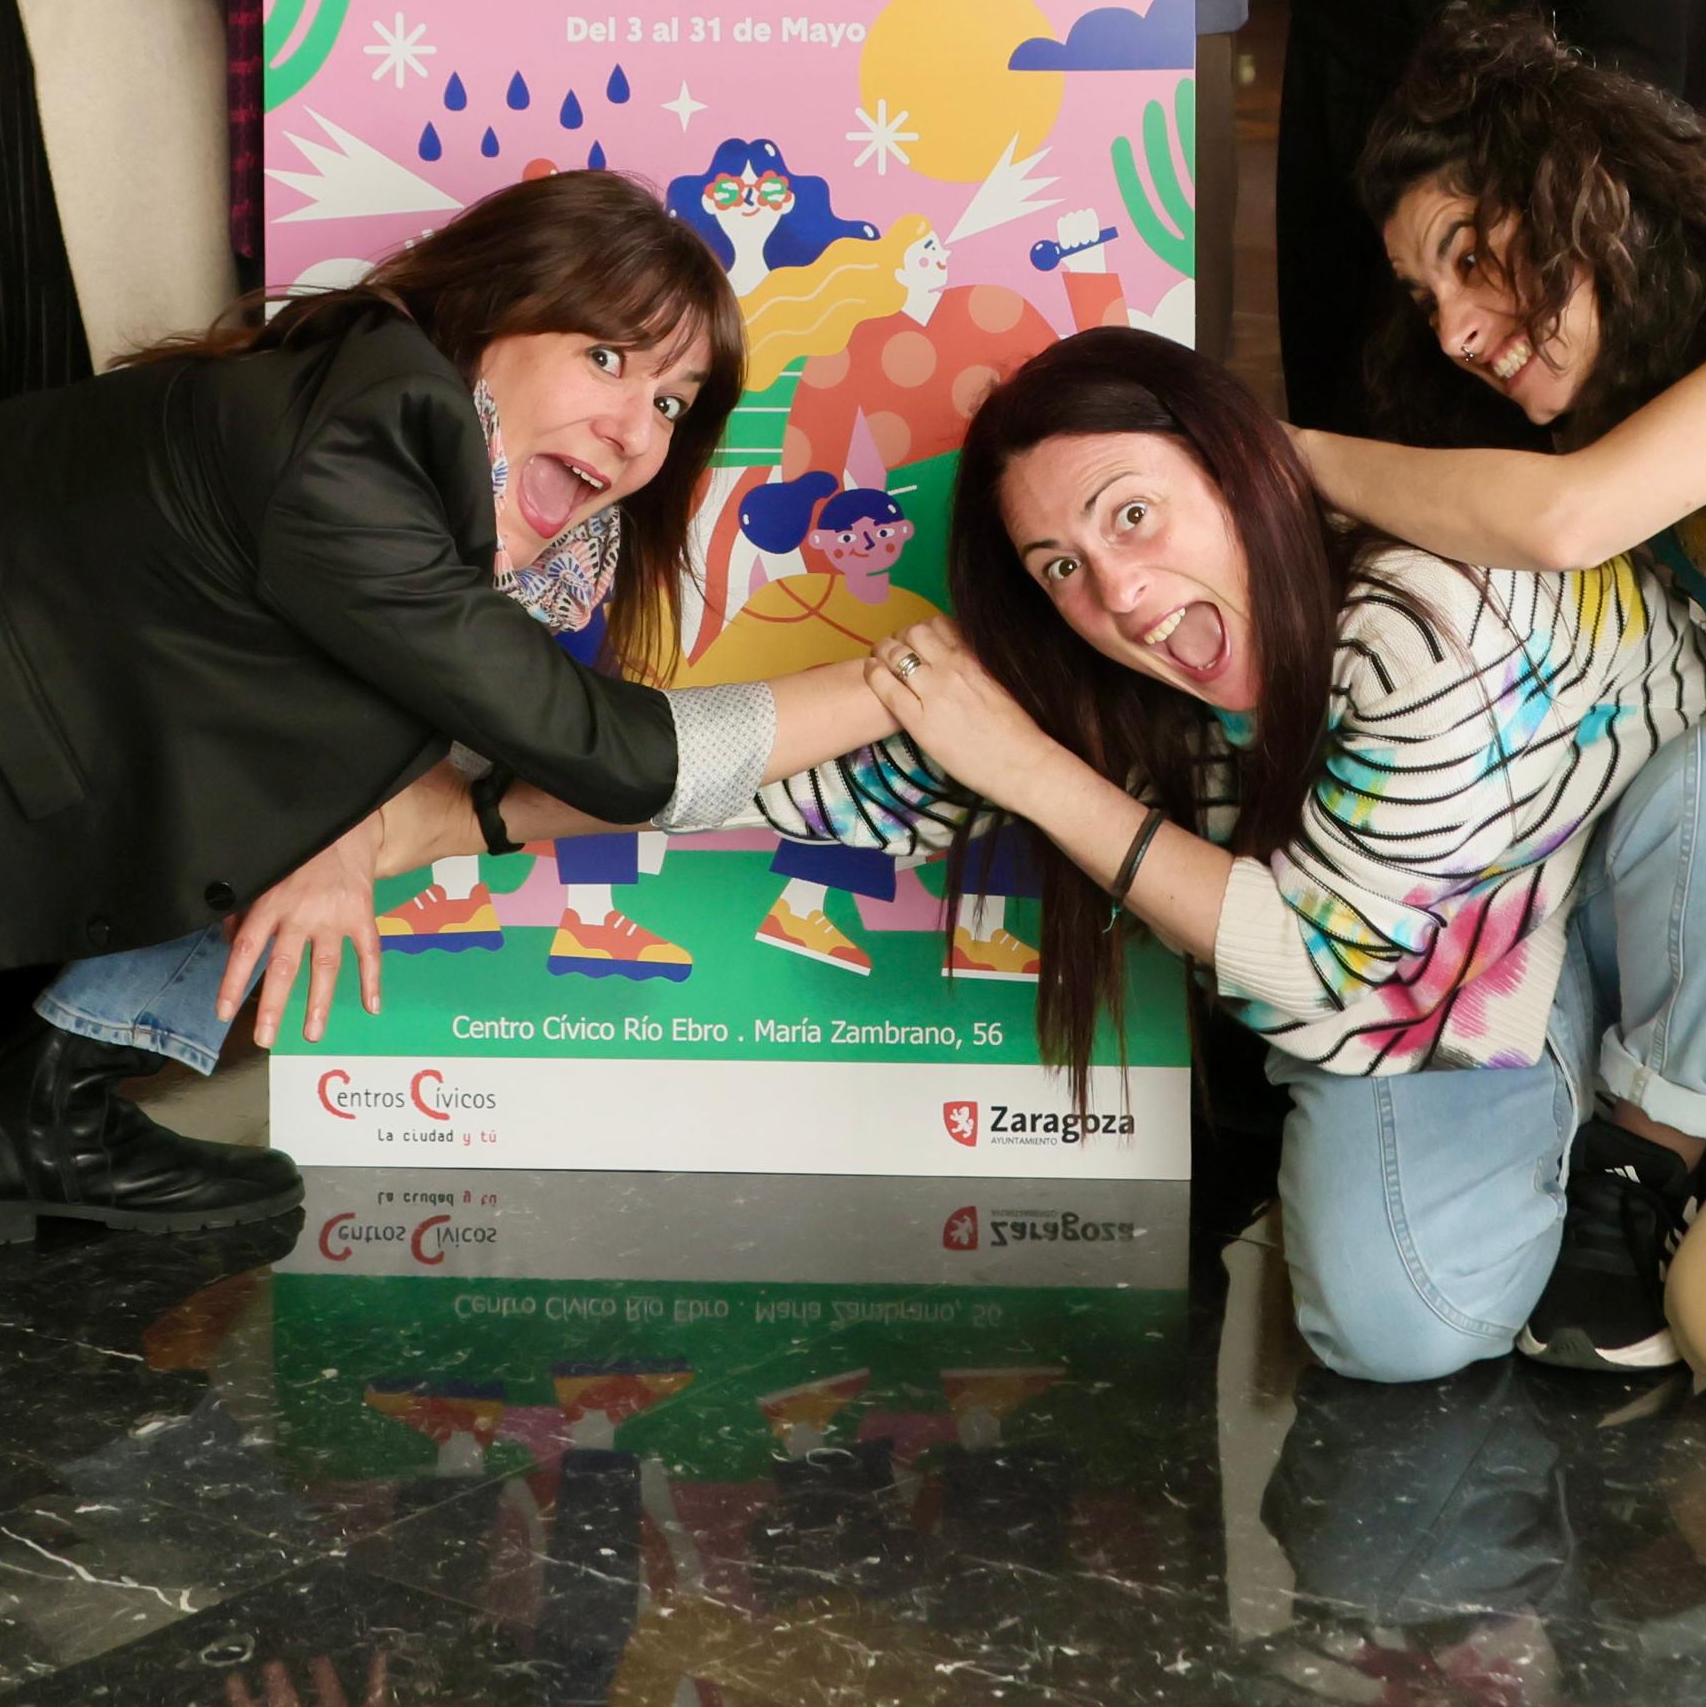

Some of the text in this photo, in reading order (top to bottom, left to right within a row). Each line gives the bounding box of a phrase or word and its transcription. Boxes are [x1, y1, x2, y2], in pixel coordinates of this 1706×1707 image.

[566, 16, 866, 48] Del 3 al 31 de Mayo
[452, 1014, 535, 1040] Centro
[542, 1013, 616, 1041] Cívico
[624, 1014, 663, 1042] Río
[672, 1017, 729, 1042] Ebro
[754, 1017, 822, 1044] María
[830, 1020, 963, 1050] Zambrano,
[972, 1022, 1004, 1046] 56
[317, 1068, 497, 1121] Centros Cívicos
[403, 1129, 454, 1143] ciudad
[462, 1132, 472, 1147] y
[480, 1129, 497, 1143] tú
[990, 1105, 1135, 1144] Zaragoza
[990, 1136, 1058, 1146] AYUNTAMIENTO
